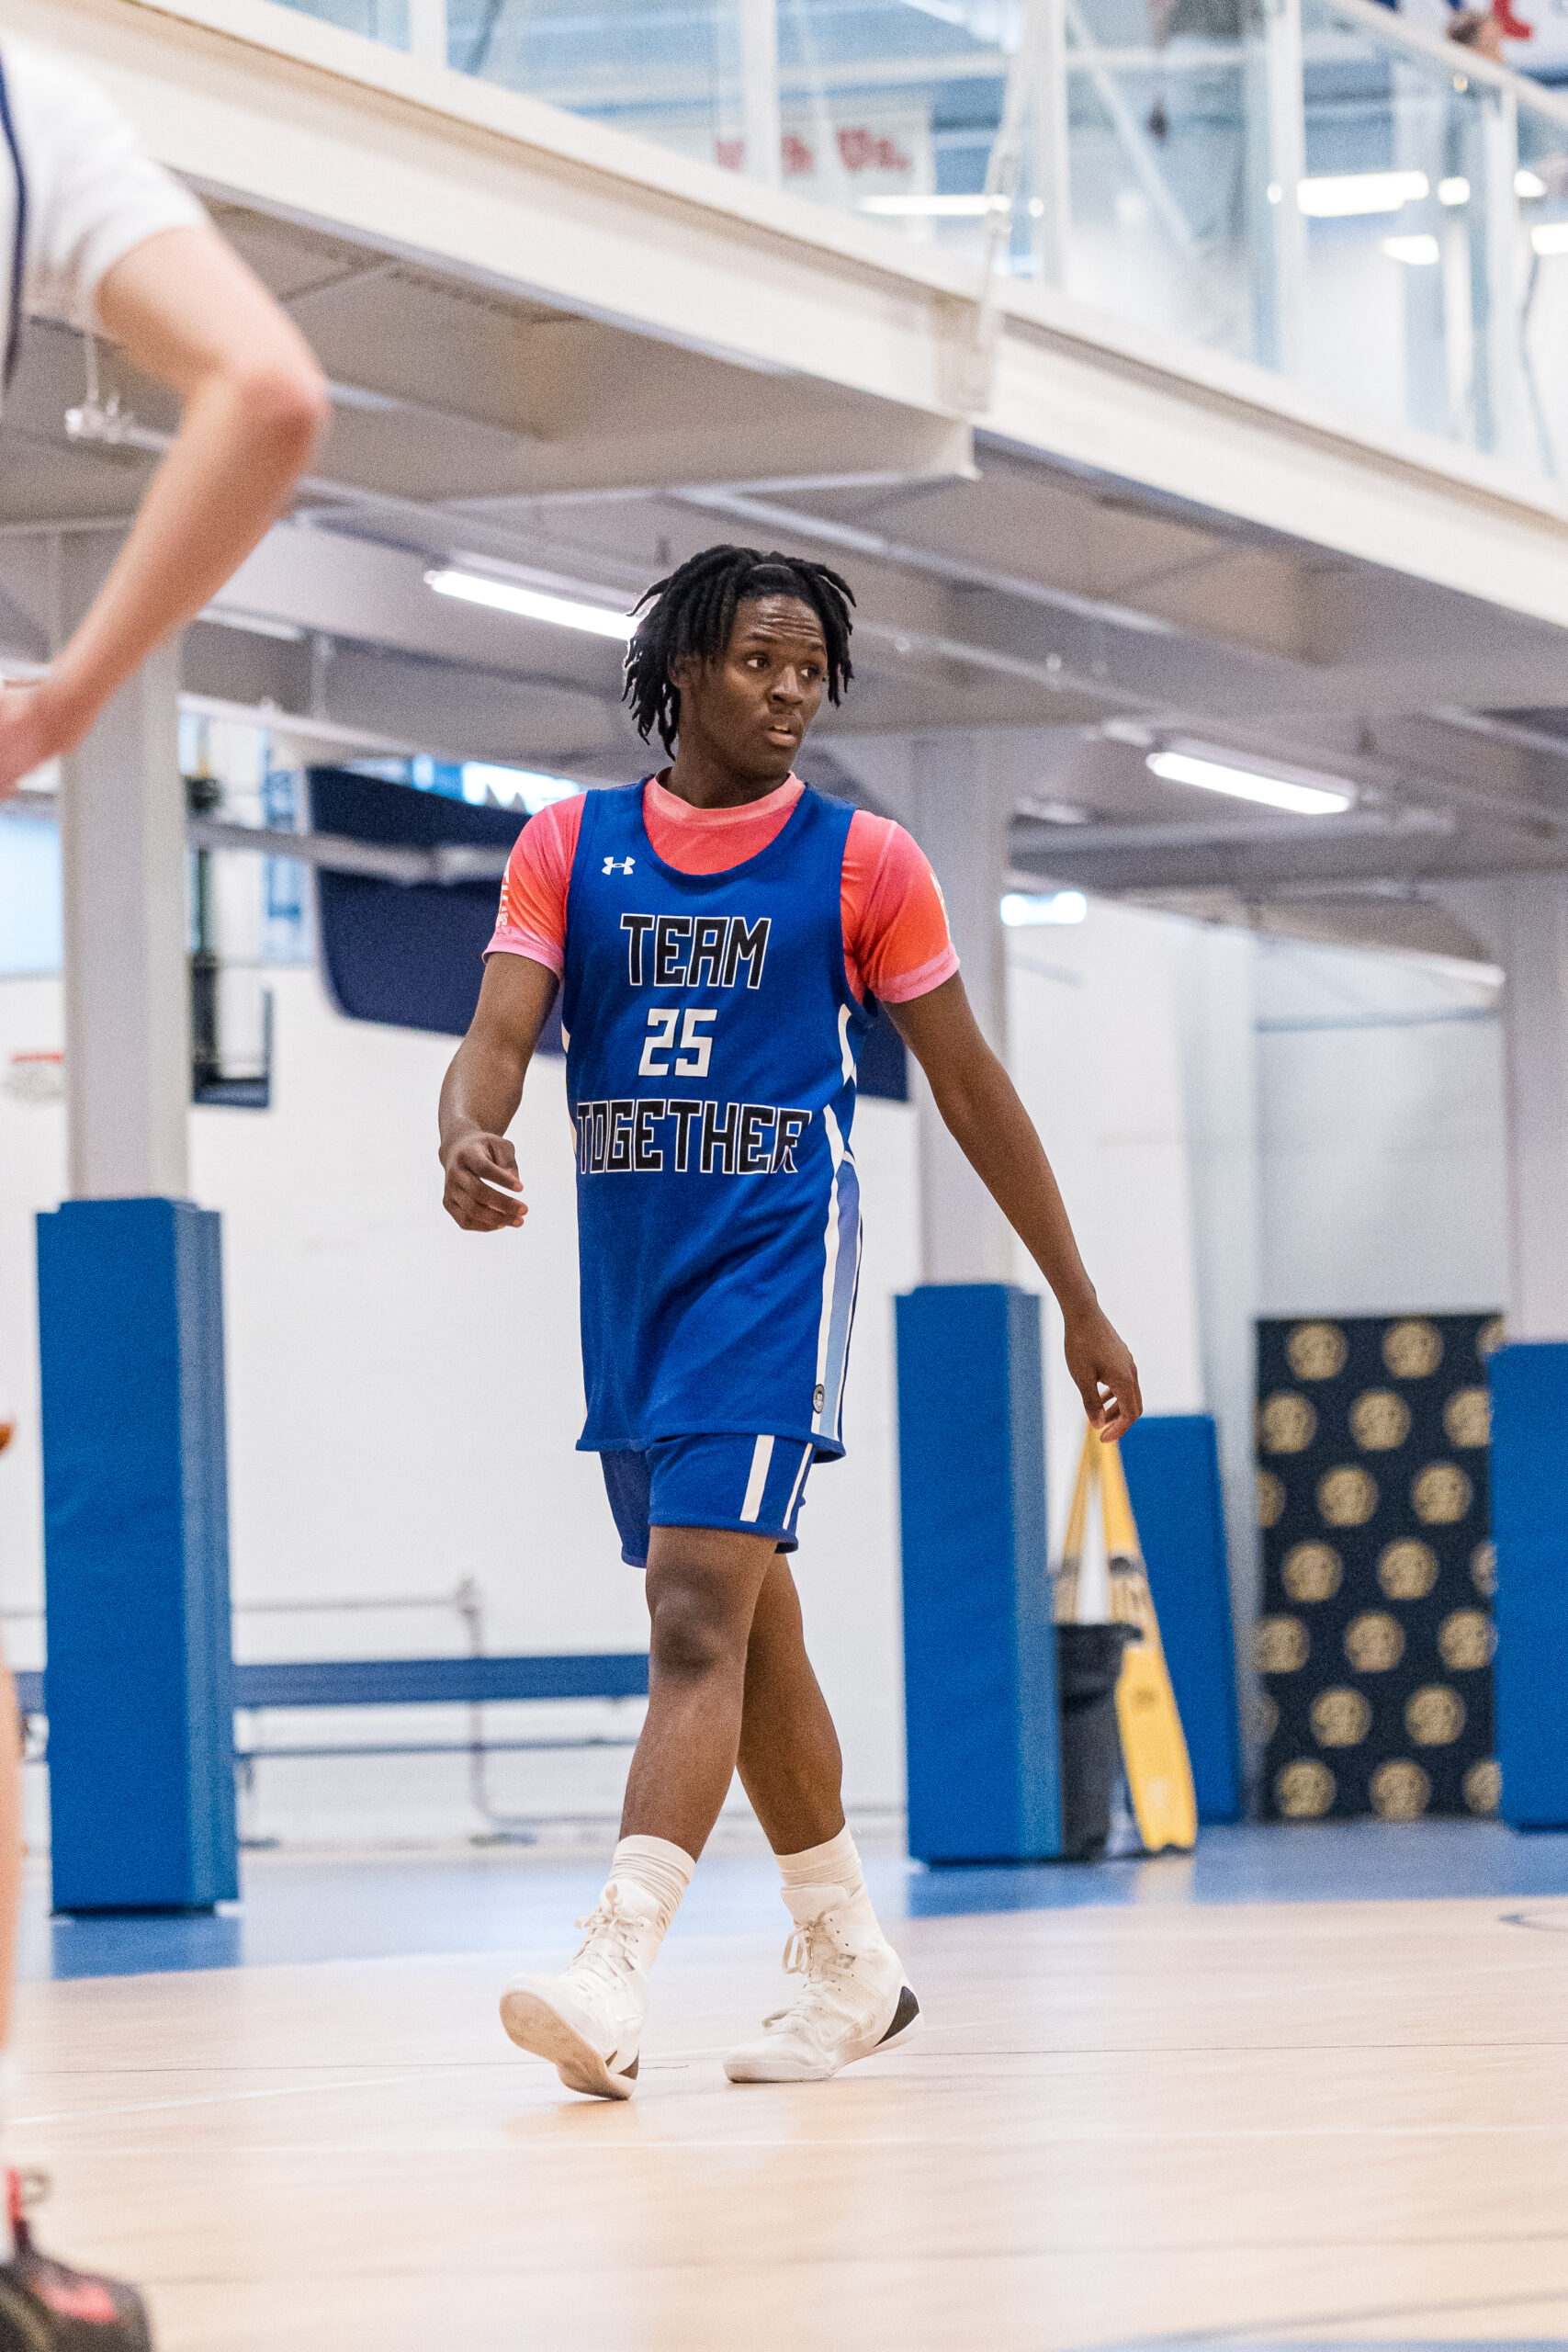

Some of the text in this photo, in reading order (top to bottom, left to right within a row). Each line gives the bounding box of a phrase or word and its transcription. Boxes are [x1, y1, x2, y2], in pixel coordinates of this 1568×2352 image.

[620, 913, 772, 989] TEAM
[637, 1008, 718, 1078] 25
[577, 1099, 812, 1174] TOGETHER
